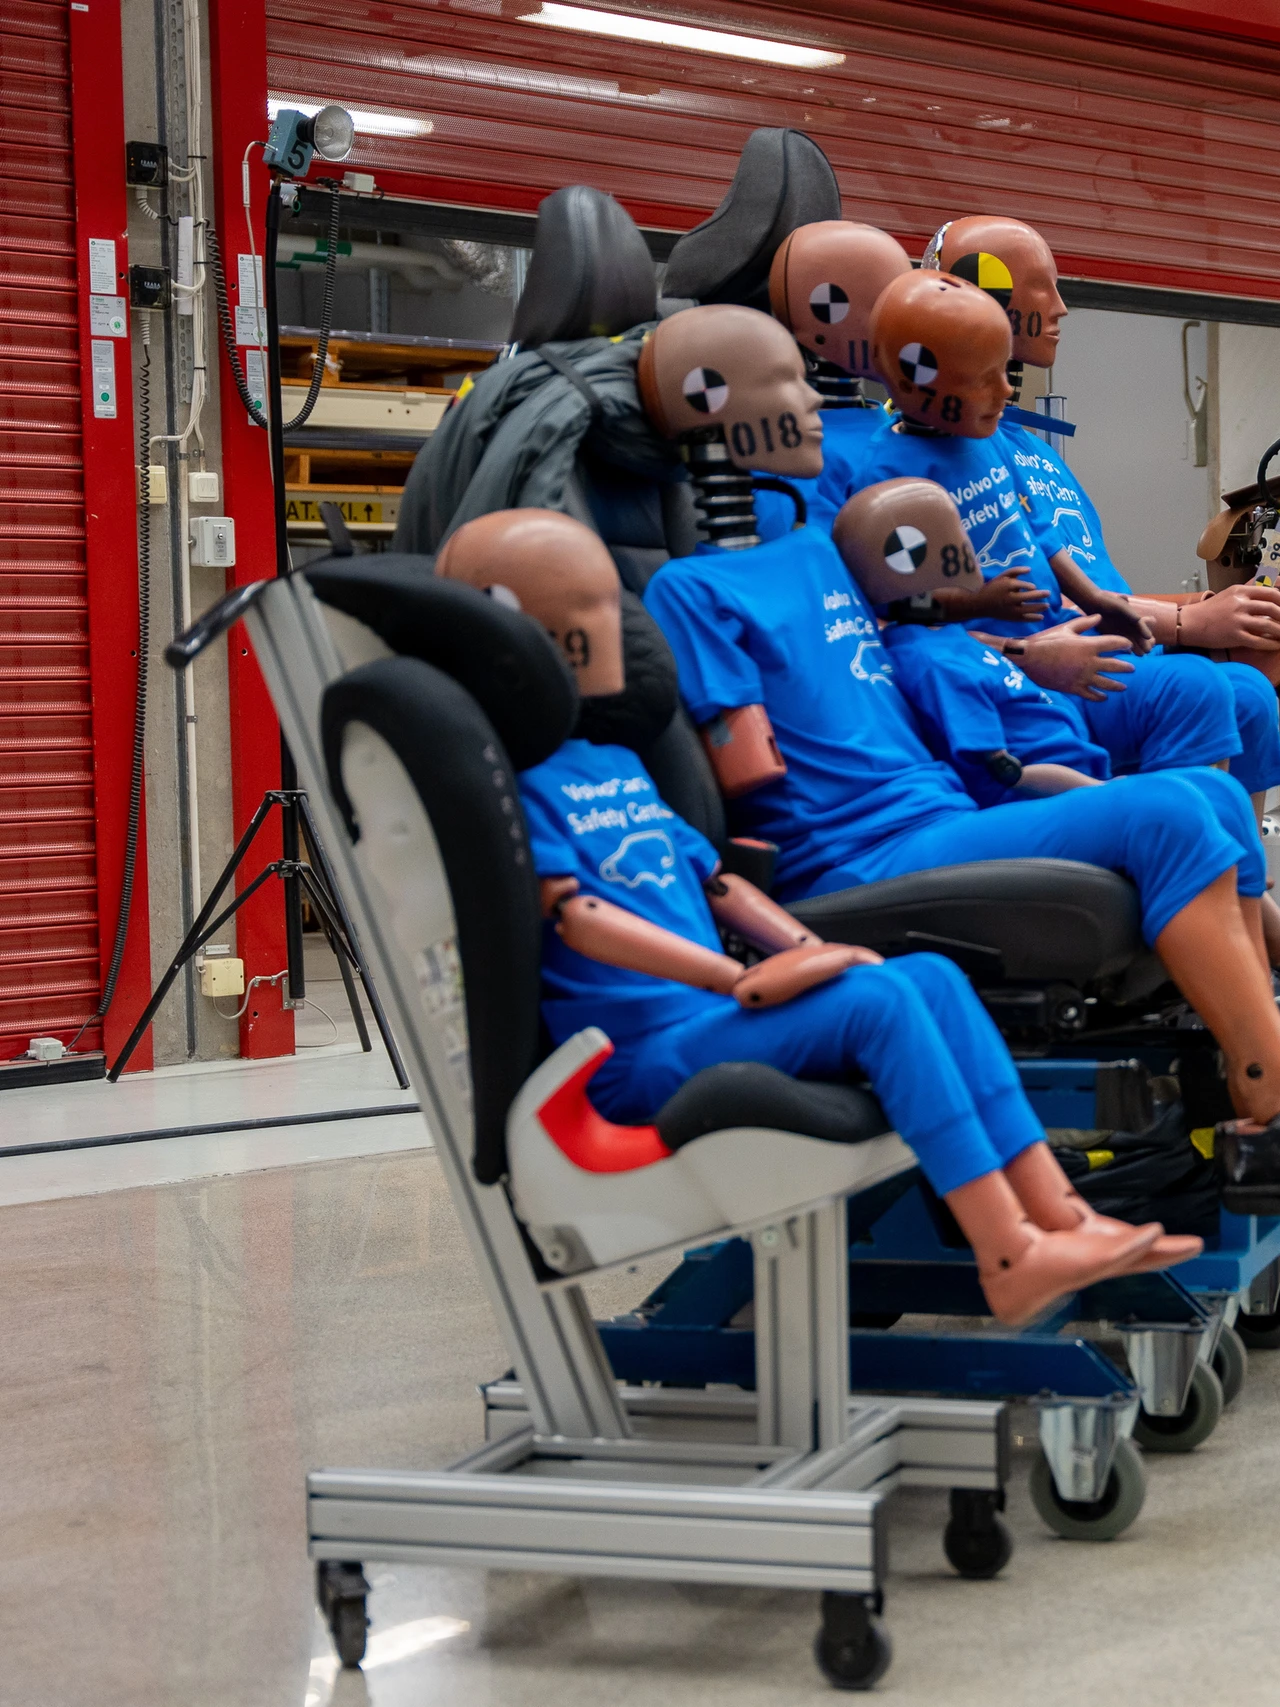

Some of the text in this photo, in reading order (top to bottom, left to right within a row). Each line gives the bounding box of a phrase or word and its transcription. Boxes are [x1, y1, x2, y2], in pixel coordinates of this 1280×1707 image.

[288, 140, 308, 170] 5
[918, 386, 963, 423] 78
[731, 411, 802, 456] 018
[960, 501, 1000, 531] afety
